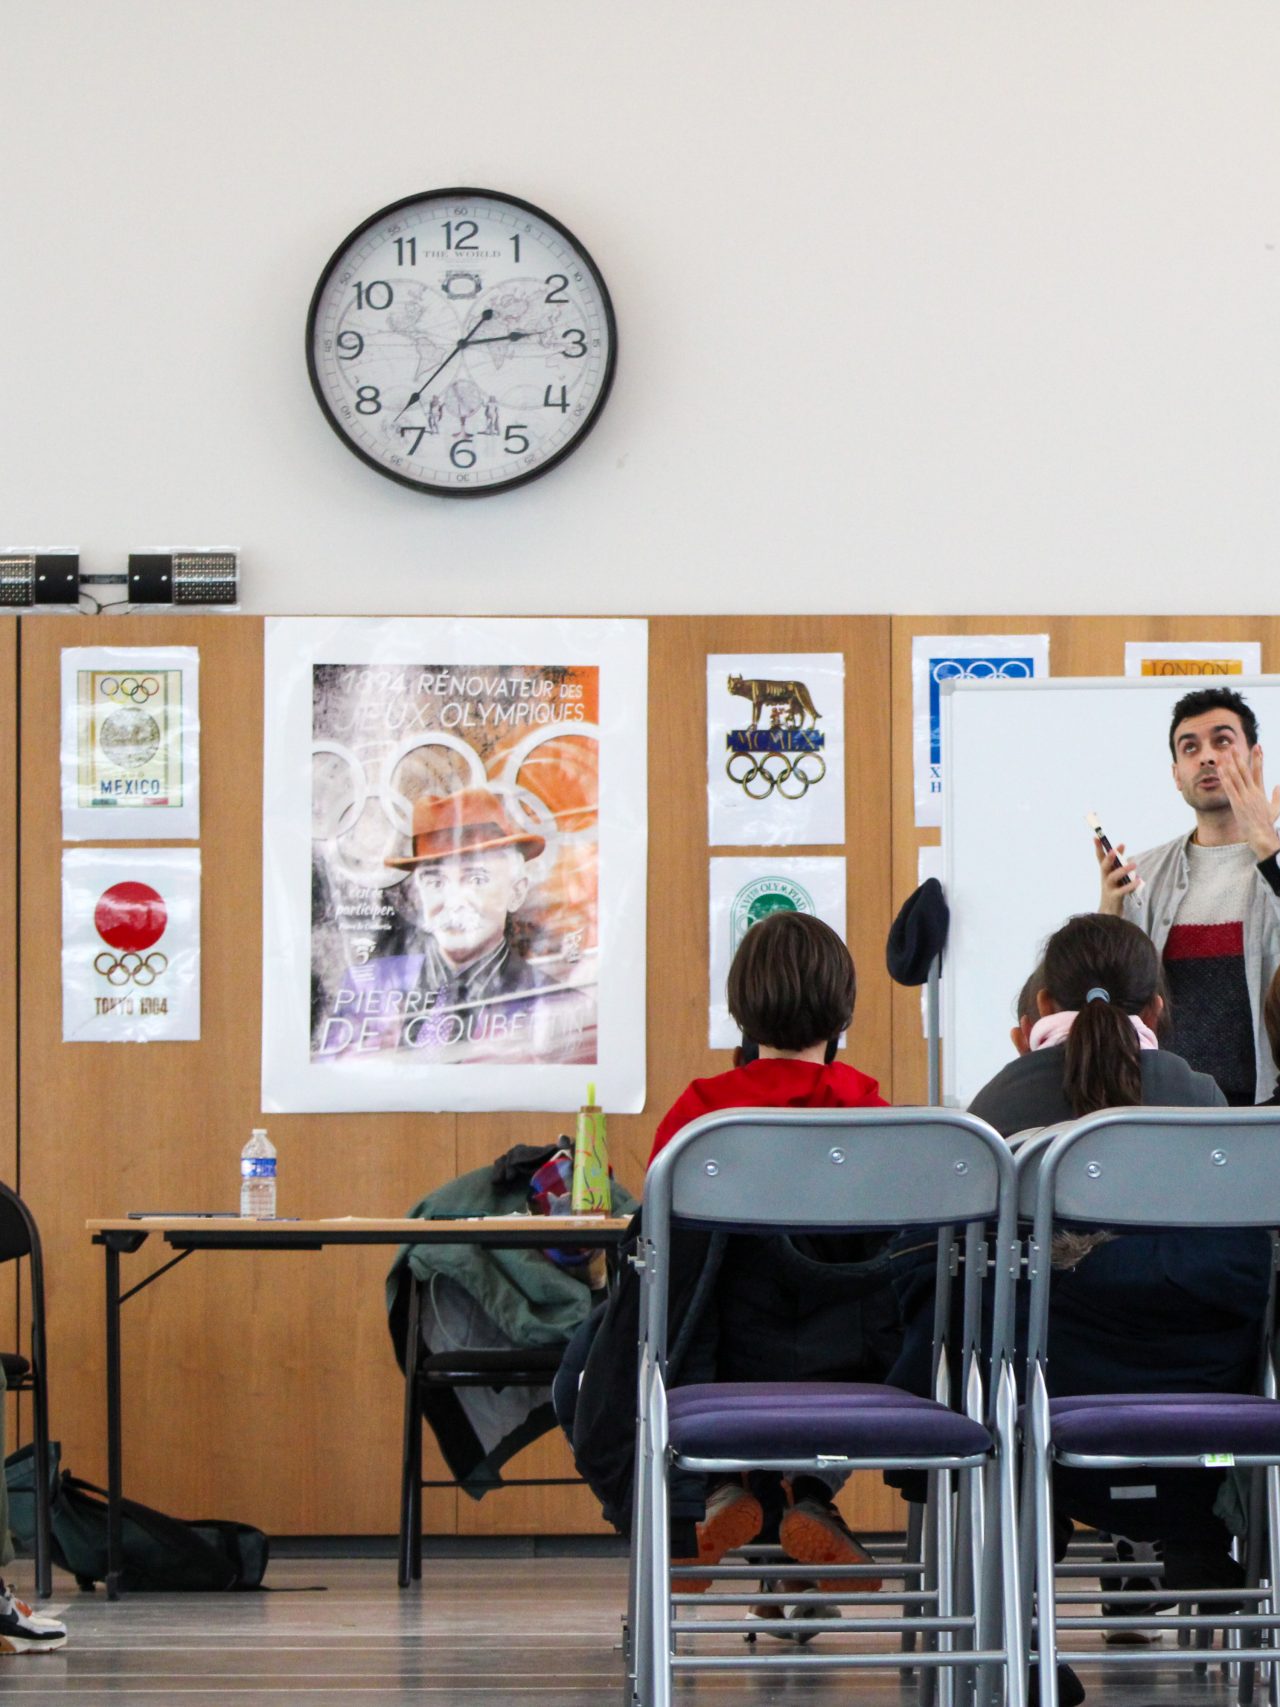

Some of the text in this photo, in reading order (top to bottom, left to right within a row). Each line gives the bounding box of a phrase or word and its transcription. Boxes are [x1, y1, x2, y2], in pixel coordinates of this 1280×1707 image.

[441, 220, 479, 250] 12
[509, 233, 520, 263] 1
[393, 237, 416, 266] 11
[352, 280, 394, 310] 10
[544, 273, 570, 304] 2
[336, 330, 365, 360] 9
[561, 328, 588, 358] 3
[355, 385, 382, 415] 8
[543, 384, 571, 414] 4
[400, 426, 426, 455] 7
[449, 439, 477, 469] 6
[503, 424, 530, 455] 5
[1152, 661, 1230, 676] LONDON
[417, 670, 554, 698] RÉNOVATEUR
[559, 684, 584, 698] DES
[334, 701, 585, 731] JEUX OLYMPIQUES
[100, 779, 161, 796] MEXICO
[333, 989, 441, 1014] PIERRE
[318, 1016, 383, 1056] DE
